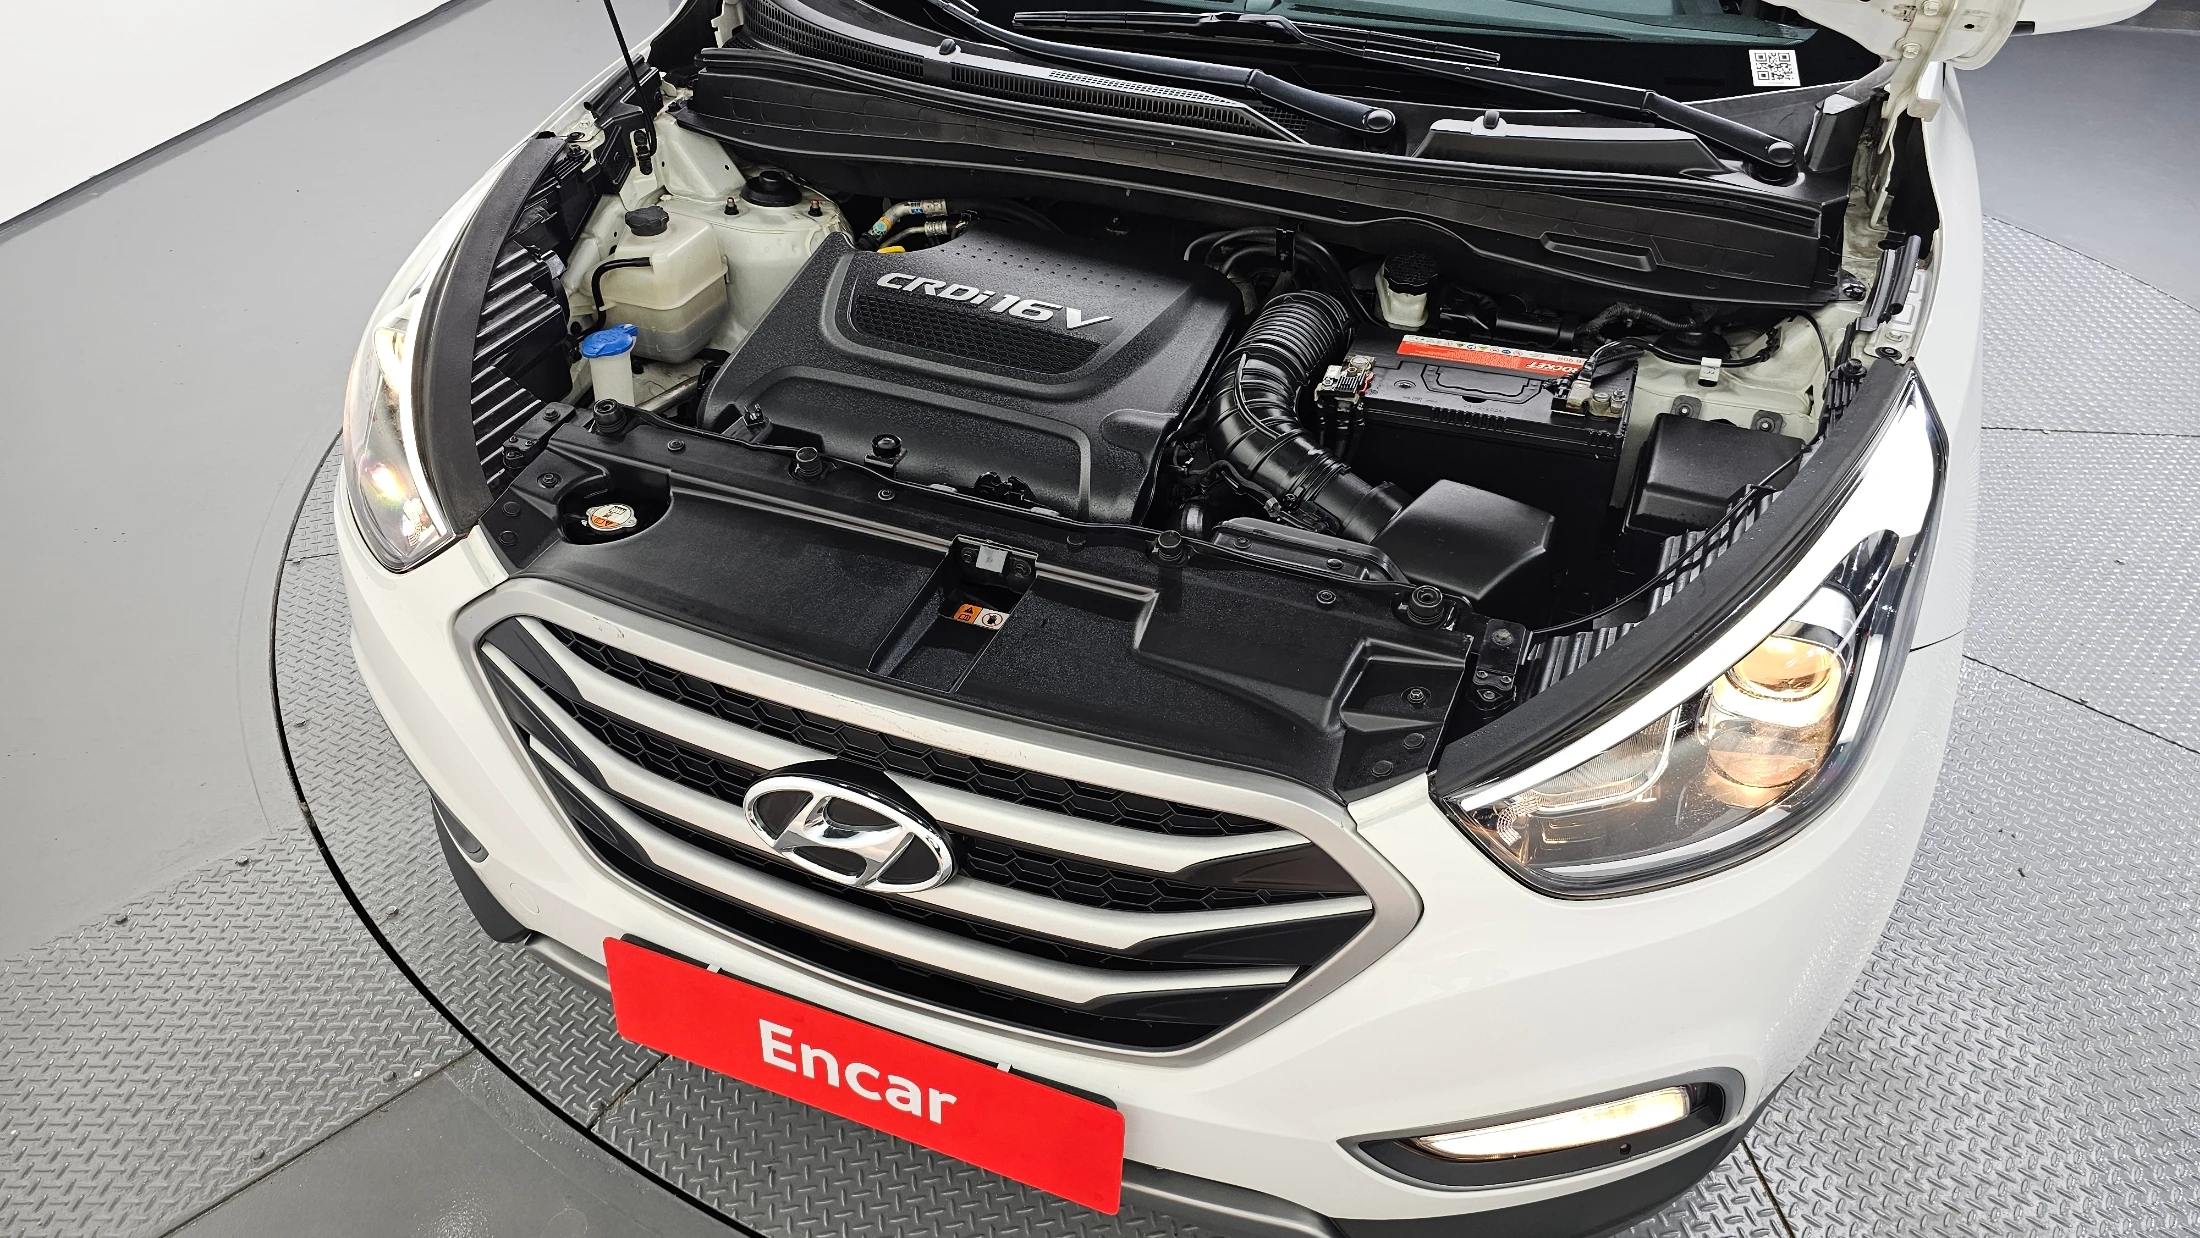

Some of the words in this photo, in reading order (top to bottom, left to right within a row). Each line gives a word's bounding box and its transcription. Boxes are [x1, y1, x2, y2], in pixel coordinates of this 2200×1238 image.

[877, 273, 996, 305] CRDi
[989, 294, 1113, 331] 16V
[759, 1018, 958, 1125] Encar
